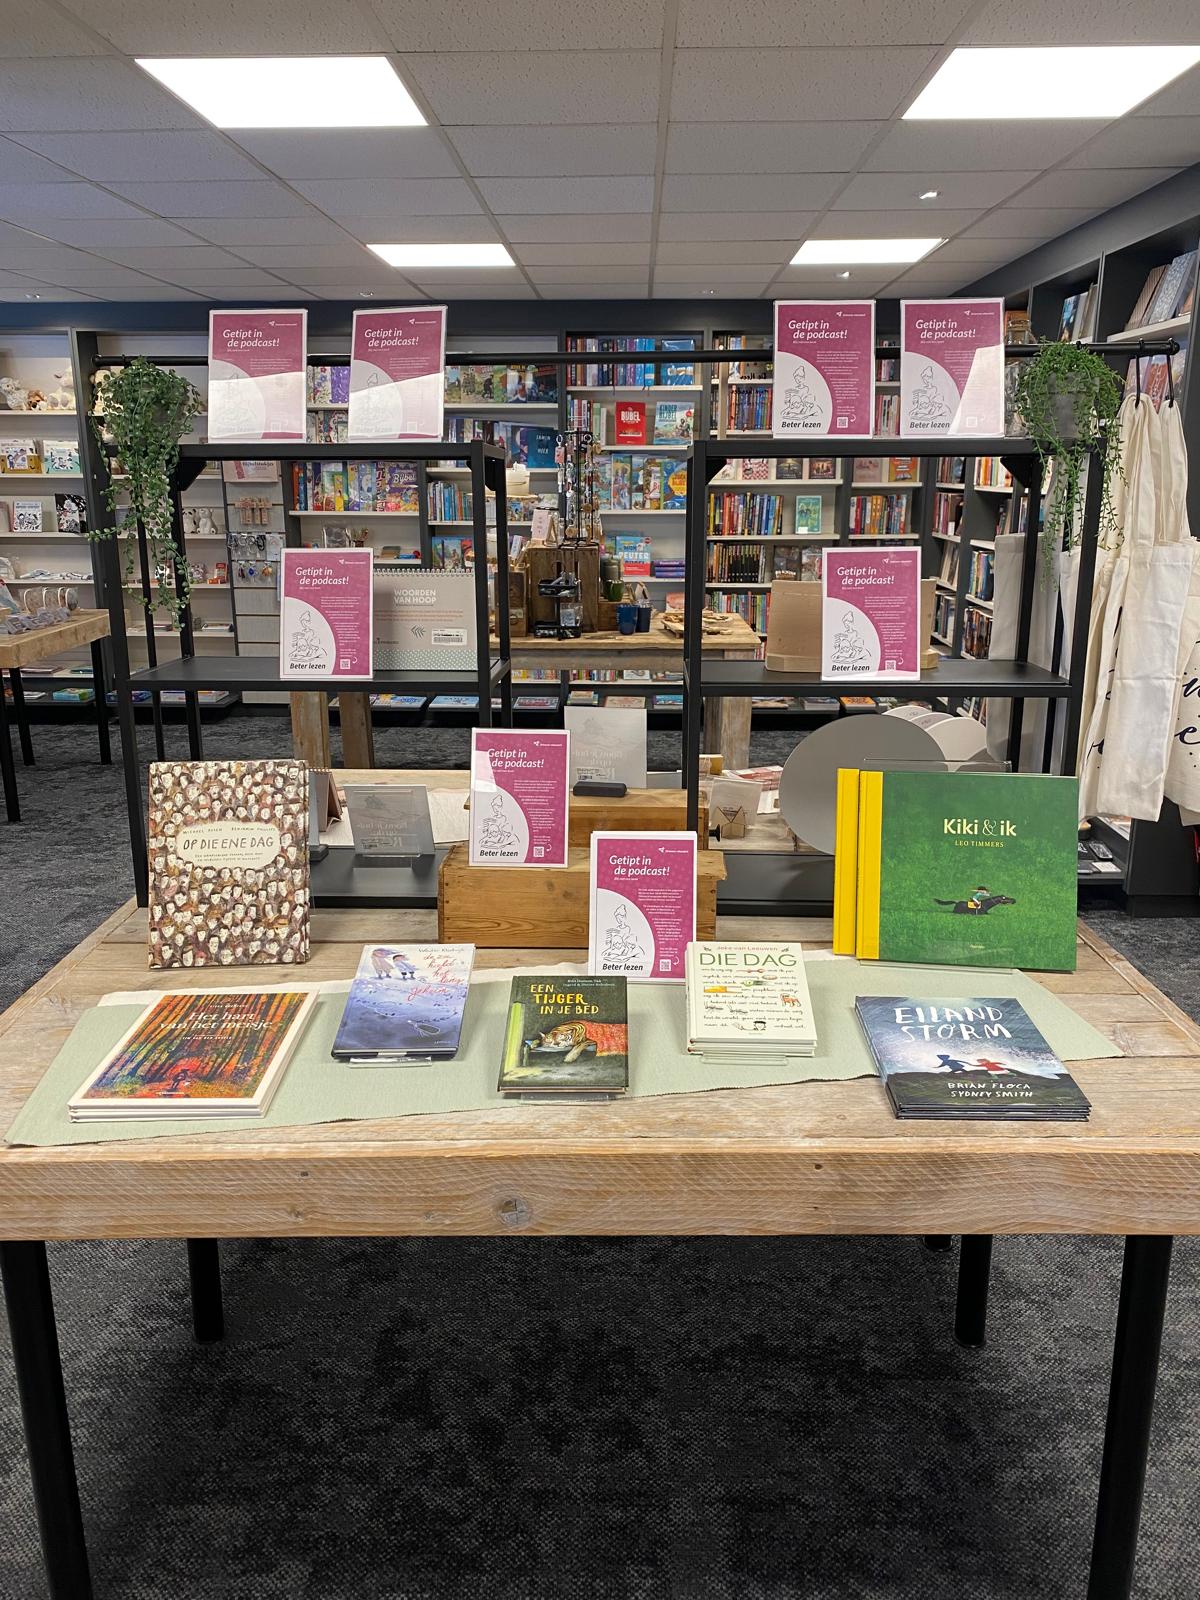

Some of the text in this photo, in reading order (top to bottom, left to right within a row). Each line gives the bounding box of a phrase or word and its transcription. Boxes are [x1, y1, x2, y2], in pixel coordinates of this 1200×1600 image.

[788, 320, 829, 330] Getipt in
[916, 319, 957, 330] Getipt in
[223, 329, 262, 339] Getipt in
[365, 329, 402, 339] Getipt in
[793, 329, 847, 340] de podcast!
[921, 329, 975, 339] de podcast!
[228, 339, 280, 348] de podcast!
[369, 337, 419, 348] de podcast!
[295, 567, 333, 577] Getipt in
[837, 566, 877, 577] Getipt in
[300, 576, 349, 586] de podcast!
[842, 576, 894, 586] de podcast!
[488, 749, 527, 759] Getipt in
[492, 759, 544, 769] de podcast!
[943, 819, 1017, 837] Kiki & ik
[183, 836, 273, 850] OP DIE ENE DAG
[971, 840, 1004, 848] TIMMERS
[609, 855, 652, 867] Getipt in
[614, 865, 670, 877] de podcast!
[700, 953, 797, 967] DIE DAG
[623, 963, 643, 971] lezen
[530, 984, 554, 993] EEN
[533, 993, 588, 1004] TIJGER
[540, 1005, 599, 1014] IN JE BED
[189, 1012, 256, 1020] Het hart
[894, 1006, 1002, 1024] EILAND
[192, 1021, 220, 1029] het
[221, 1020, 272, 1030] meisje
[901, 1023, 1012, 1042] STORM
[992, 1082, 1030, 1090] FLOCA
[950, 1090, 992, 1098] SYDNEY
